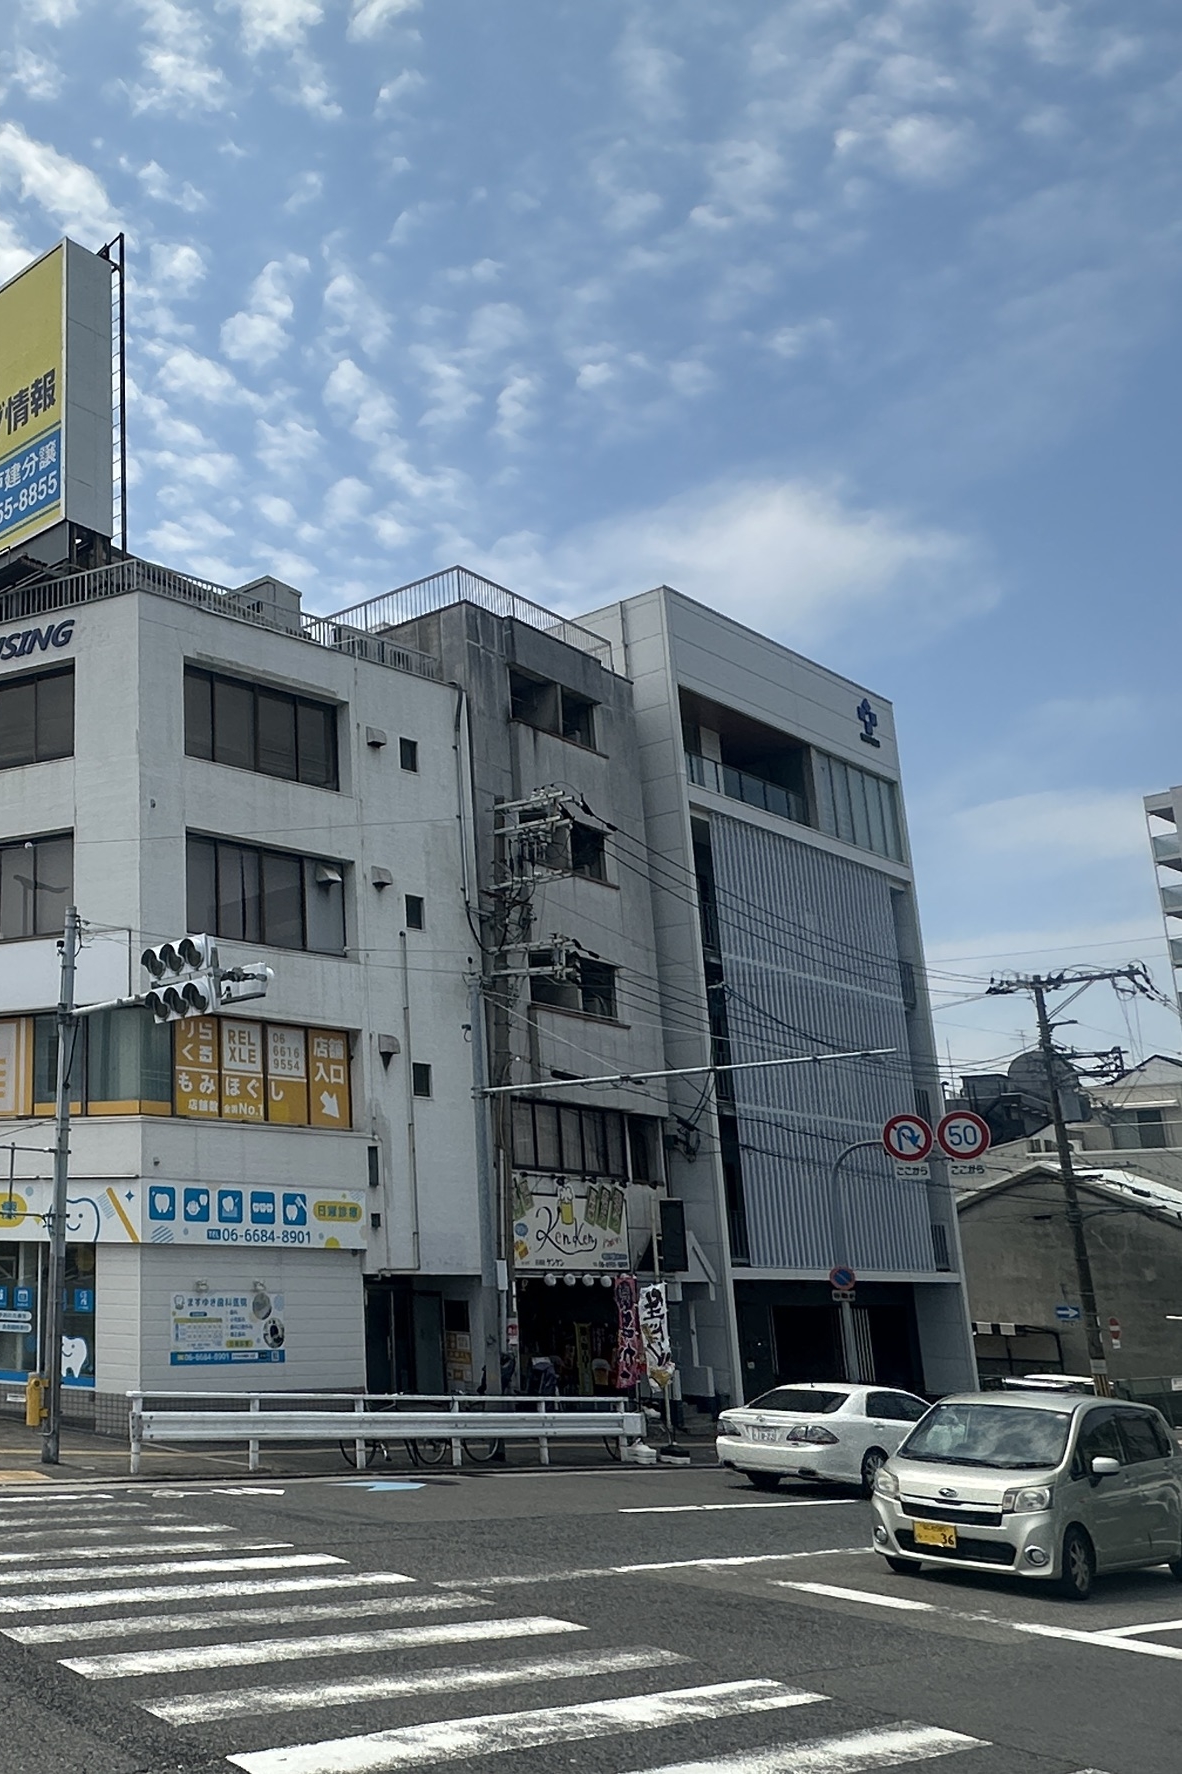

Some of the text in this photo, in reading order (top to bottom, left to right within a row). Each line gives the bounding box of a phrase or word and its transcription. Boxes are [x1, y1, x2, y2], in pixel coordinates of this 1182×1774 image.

[227, 1029, 256, 1046] REL
[273, 1033, 285, 1043] 06
[229, 1046, 256, 1064] XLE
[273, 1046, 300, 1058] 6616
[313, 1037, 344, 1060] 店舗
[273, 1059, 300, 1071] 9554
[315, 1062, 345, 1085] 入口
[179, 1072, 284, 1101] もみほぐし
[948, 1125, 978, 1147] 50
[896, 1166, 928, 1176] ここから
[950, 1165, 985, 1175] ここから
[222, 1228, 311, 1244] 06-6684-8901
